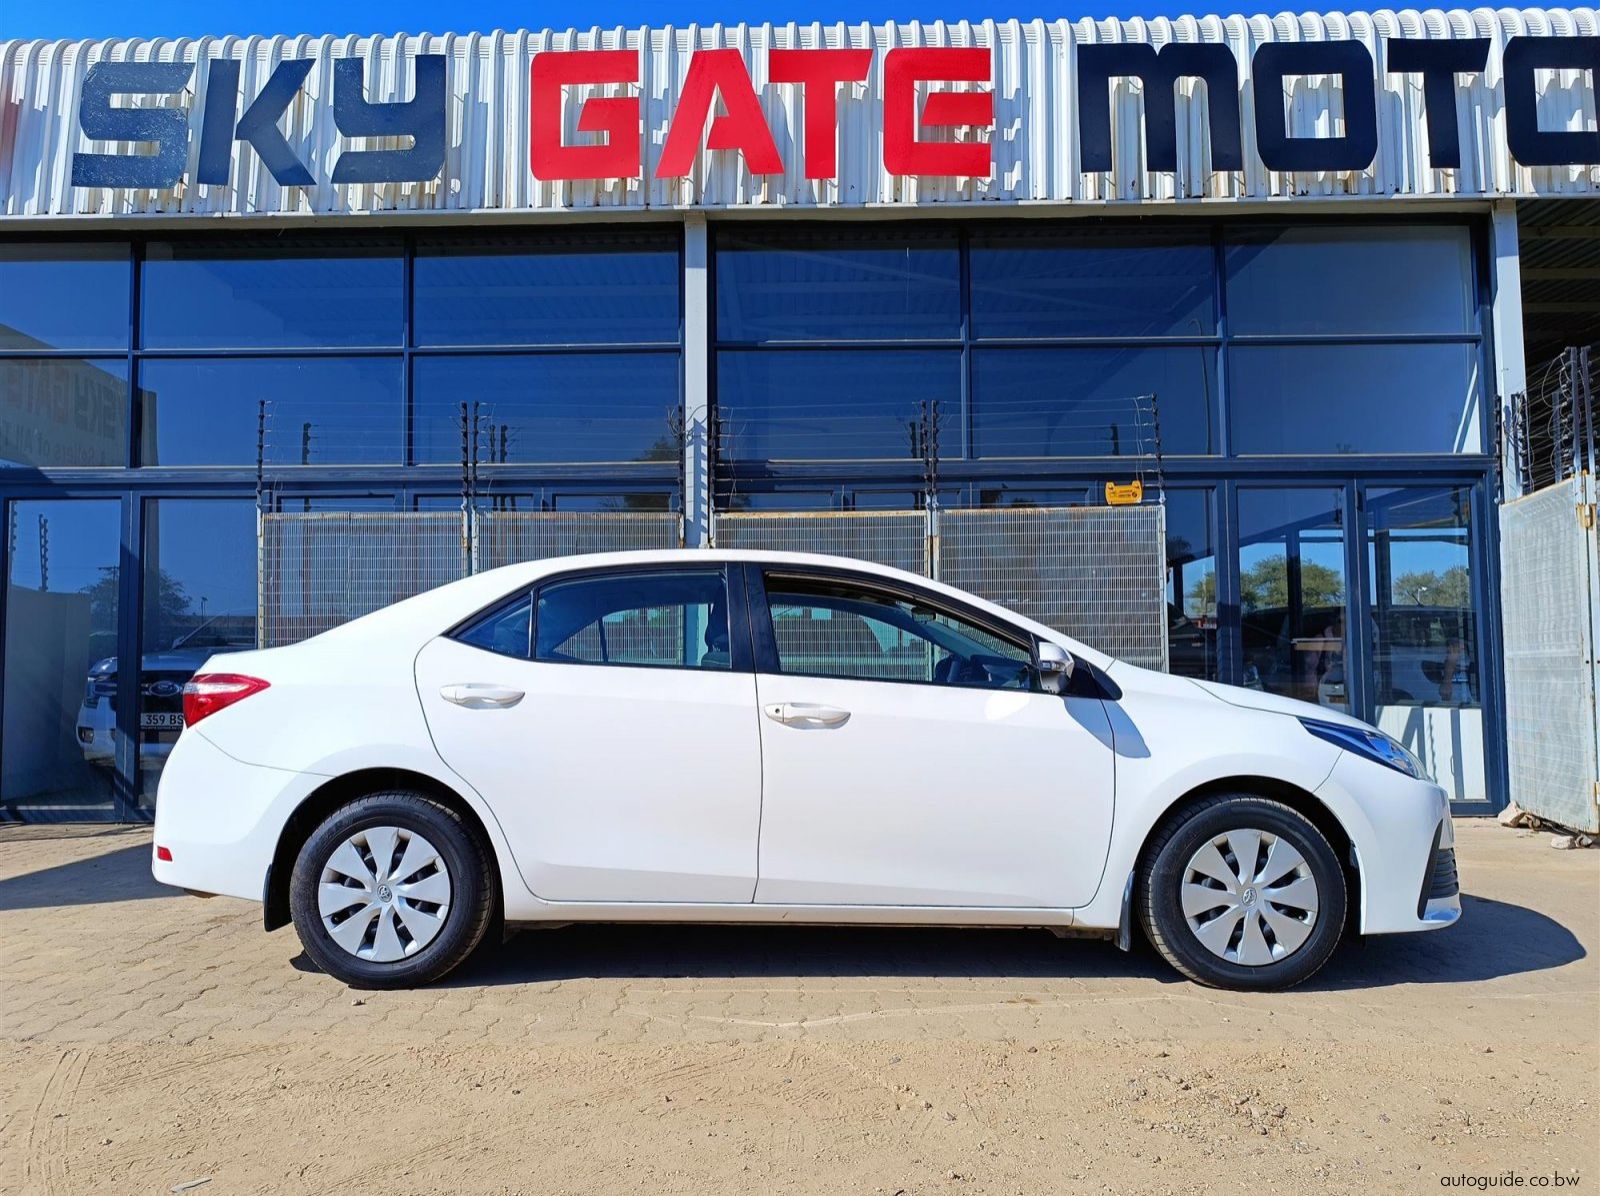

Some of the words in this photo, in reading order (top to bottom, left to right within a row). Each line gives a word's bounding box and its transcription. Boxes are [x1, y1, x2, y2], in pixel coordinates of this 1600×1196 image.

[71, 53, 447, 189] SKY
[530, 46, 994, 182] GATE
[1076, 35, 1600, 174] MOTO
[145, 714, 166, 725] 359
